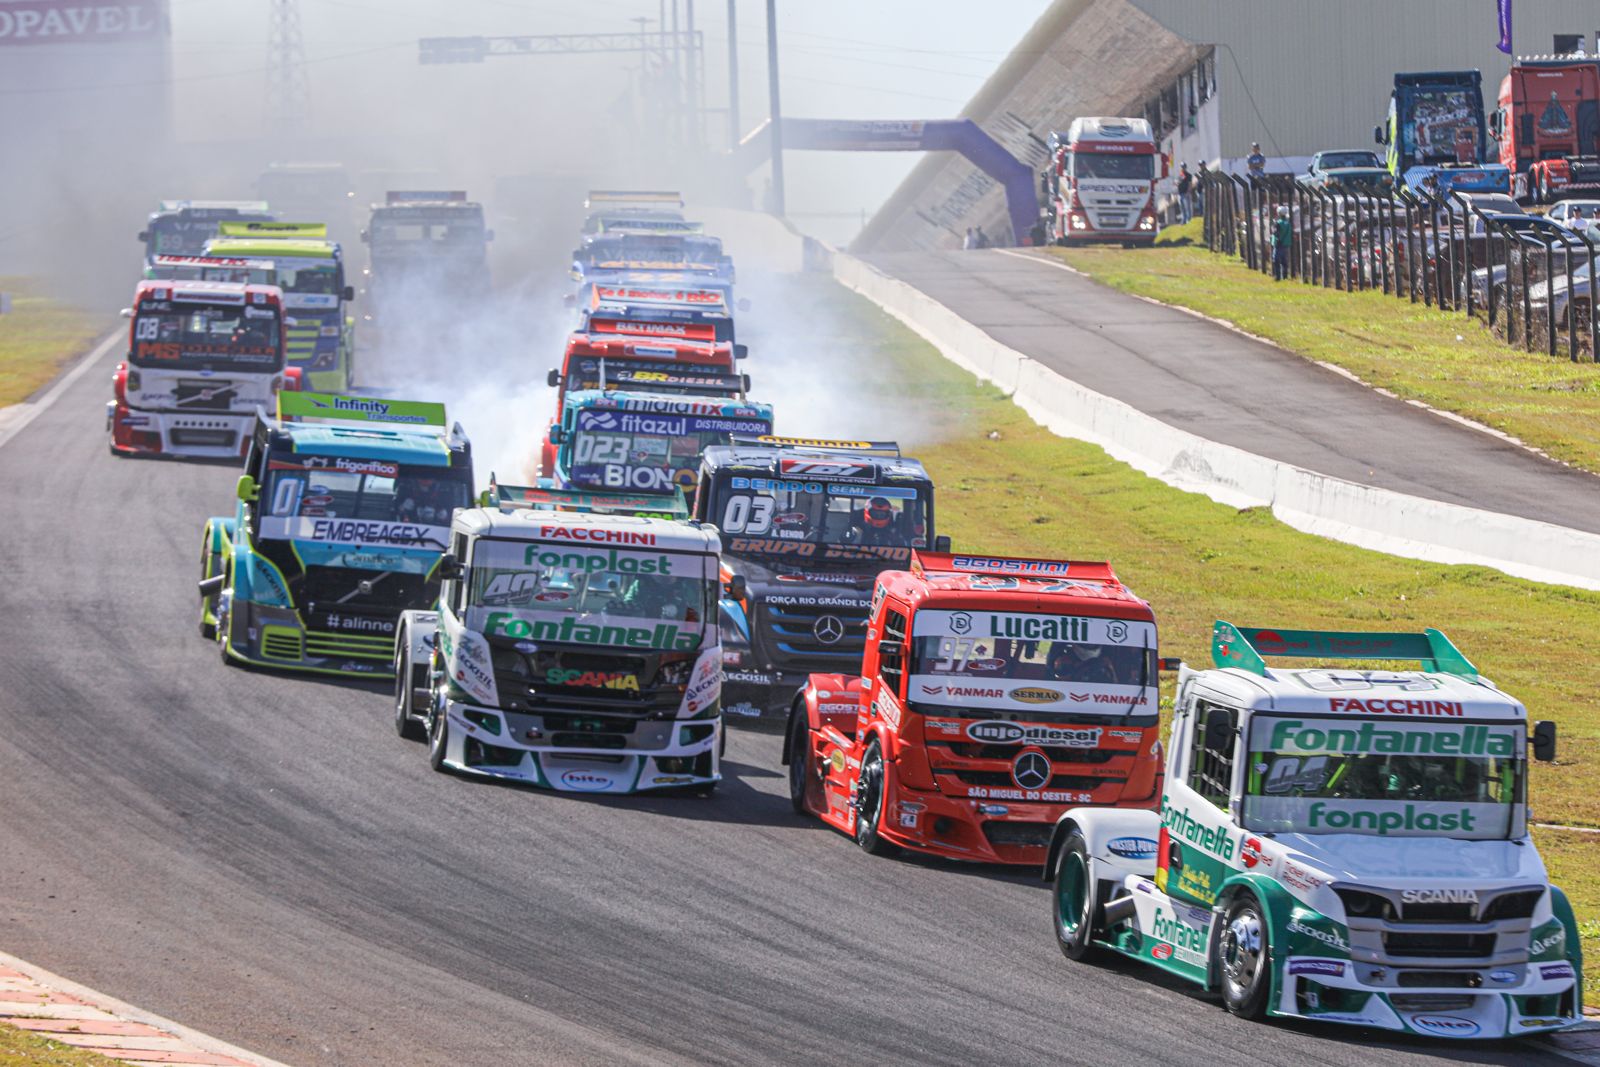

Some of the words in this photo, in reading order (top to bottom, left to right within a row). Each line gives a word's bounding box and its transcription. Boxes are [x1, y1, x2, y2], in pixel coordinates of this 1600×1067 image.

[136, 318, 159, 339] 08
[334, 398, 389, 414] Infinity
[366, 412, 426, 423] Transportes
[621, 414, 686, 435] fitazul
[696, 419, 766, 434] DISTRIBUIDORA
[723, 494, 776, 535] 03
[312, 520, 430, 546] EMBREAGEX
[540, 526, 656, 546] FACCHINI
[730, 538, 816, 556] GRUPO
[524, 545, 672, 574] fonplast
[766, 596, 796, 606] FORÇA
[818, 598, 857, 606] GRANDE
[484, 611, 702, 651] Fontanella
[990, 614, 1088, 642] Lucatti
[934, 636, 976, 672] 97
[546, 668, 641, 692] SCANIA
[946, 686, 1004, 698] YANMAR
[1013, 690, 1060, 701] SERMAQ
[1093, 694, 1148, 706] YANMAR
[1330, 698, 1464, 716] FACCHINI
[1026, 738, 1066, 746] POWER
[1270, 720, 1514, 755] Fontanella
[1265, 755, 1330, 794] 04
[968, 786, 987, 798] SÃO
[989, 788, 1024, 800] MIGUEL
[1027, 791, 1040, 800] DO
[1043, 792, 1072, 802] OESTE
[1078, 794, 1092, 802] SC
[1162, 794, 1235, 860] Fontanella
[1309, 802, 1476, 834] fonplast
[1401, 890, 1480, 903] SCANIA
